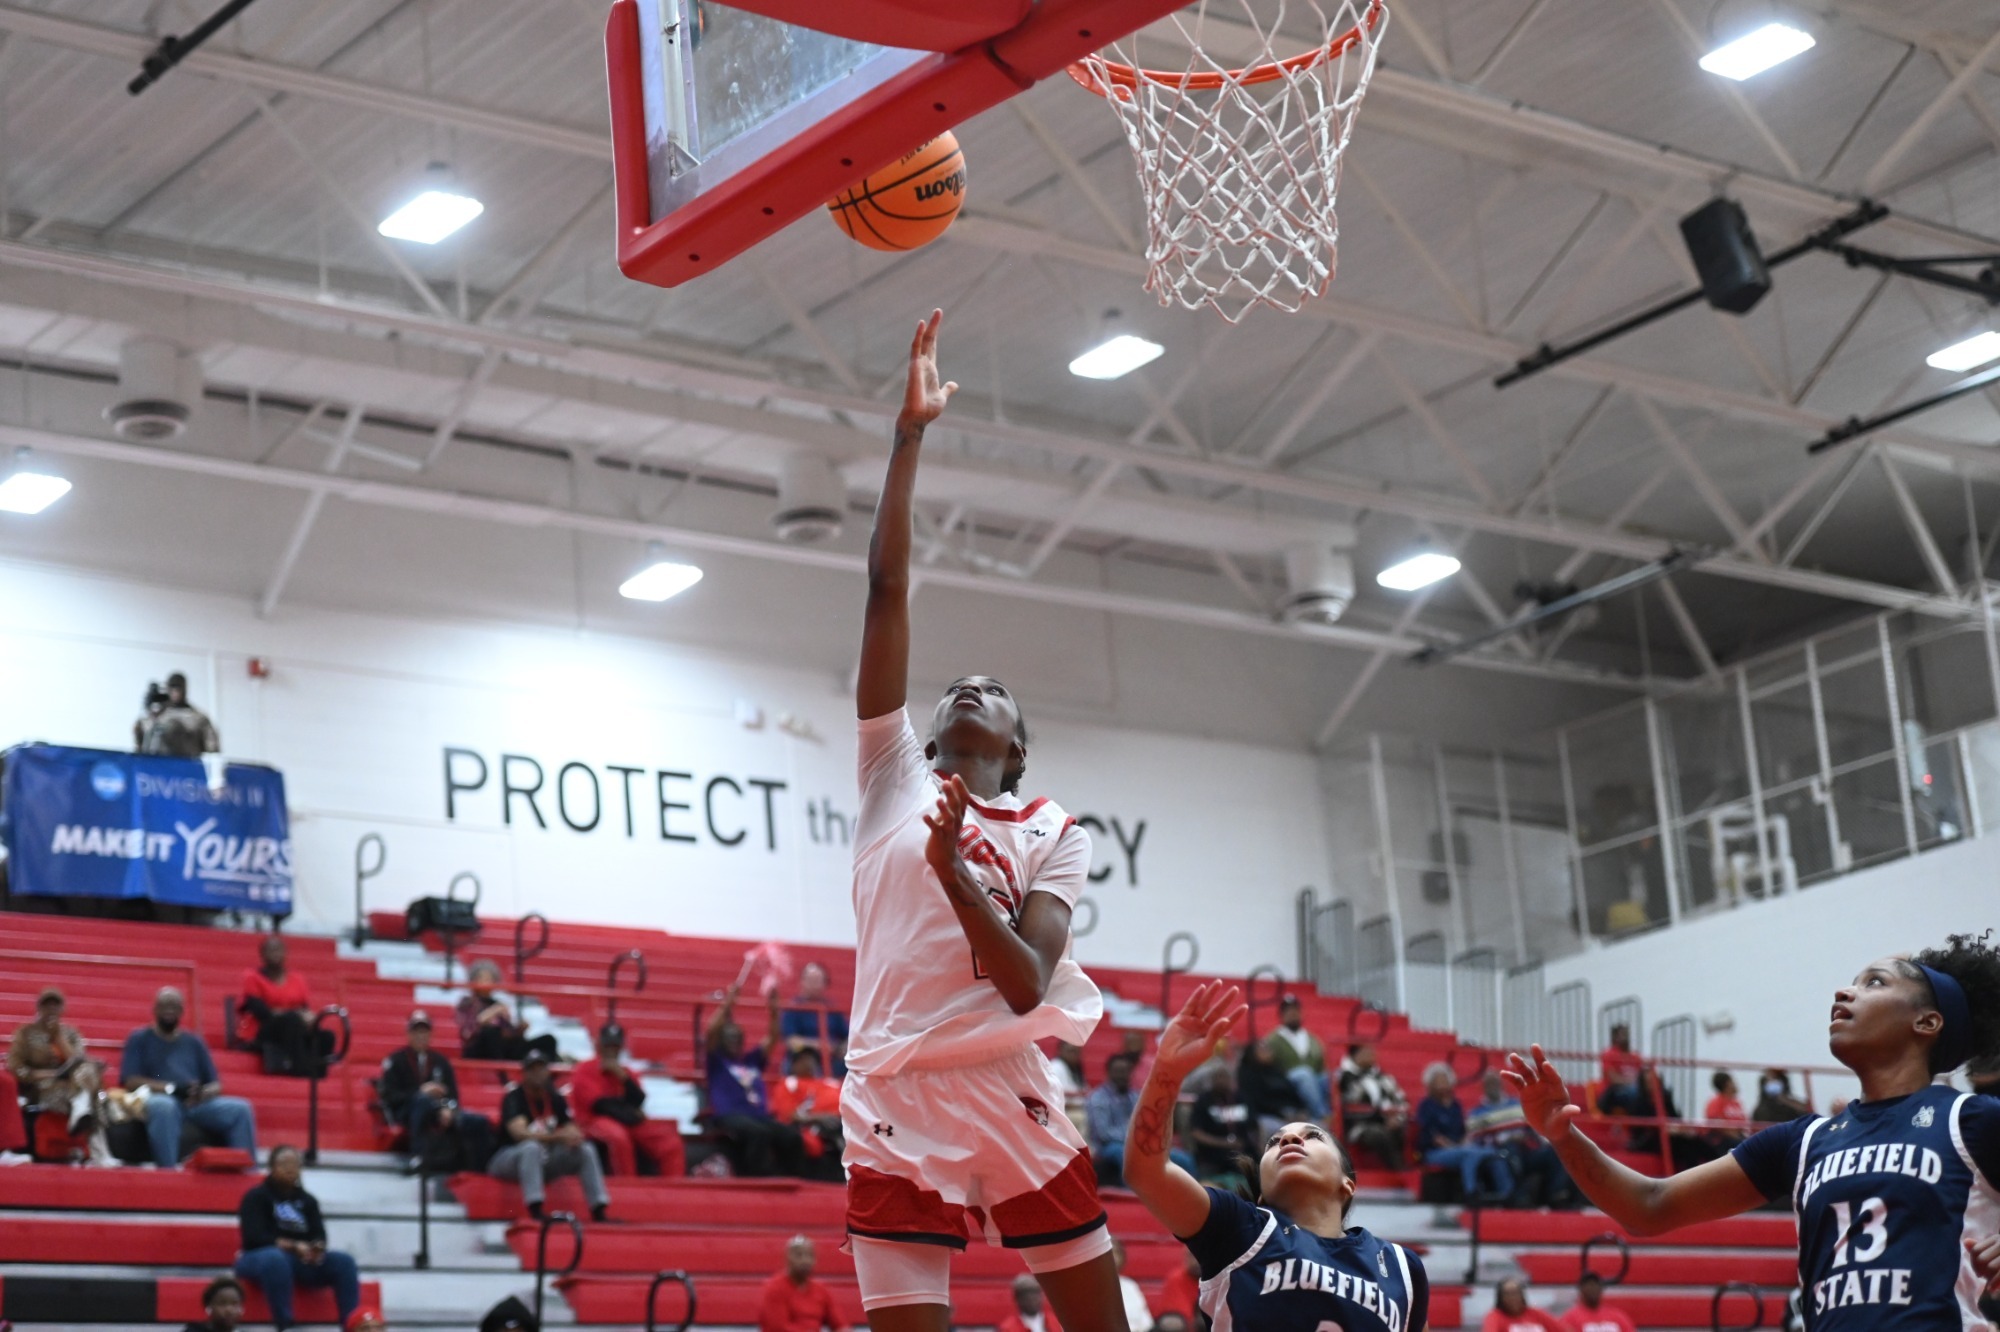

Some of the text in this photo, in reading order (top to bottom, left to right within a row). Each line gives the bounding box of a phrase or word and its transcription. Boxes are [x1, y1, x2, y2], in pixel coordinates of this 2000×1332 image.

[443, 747, 858, 851] PROTECT th
[52, 824, 144, 859] MAKE
[146, 832, 176, 862] IT
[1802, 1142, 1942, 1210] BLUEFIELD
[1829, 1197, 1888, 1269] 13
[1260, 1258, 1401, 1332] BLUEFIELD
[1813, 1269, 1913, 1316] STATE
